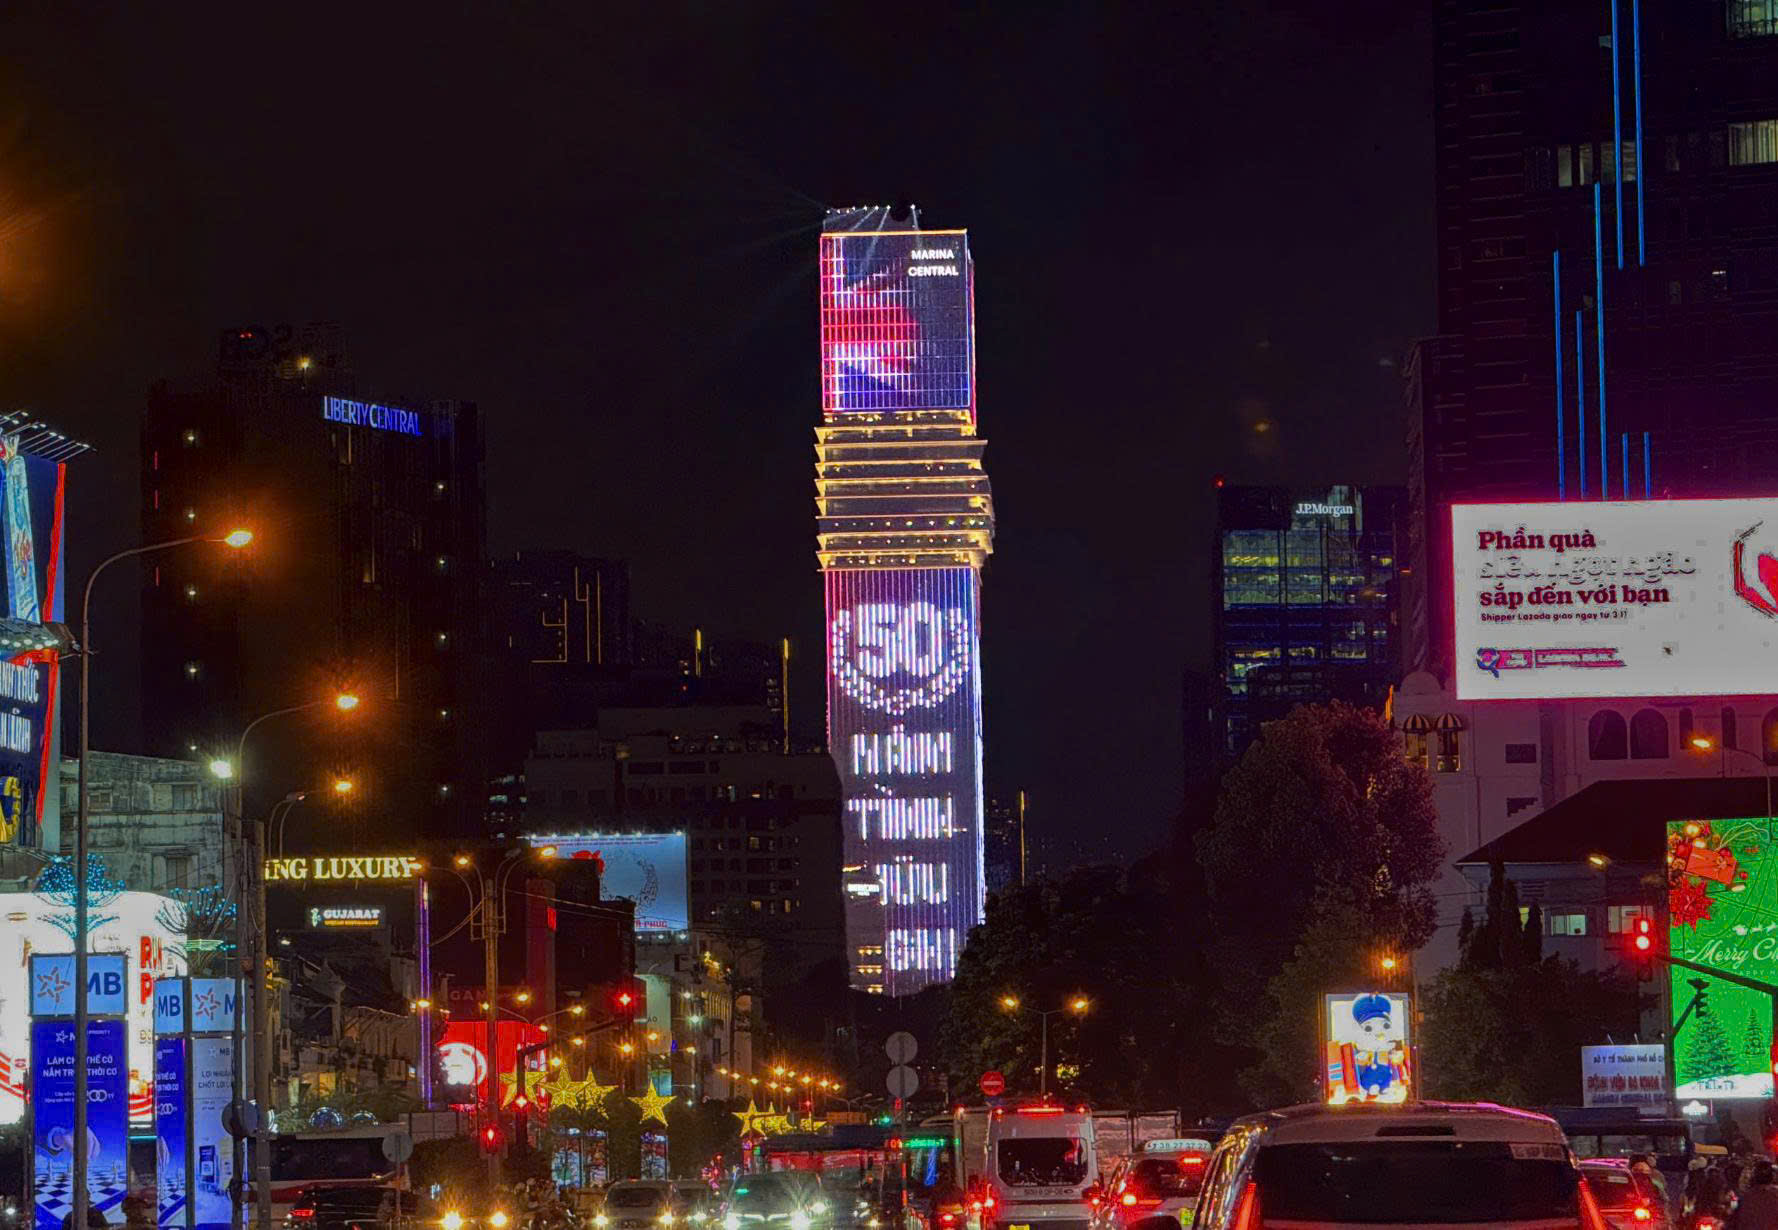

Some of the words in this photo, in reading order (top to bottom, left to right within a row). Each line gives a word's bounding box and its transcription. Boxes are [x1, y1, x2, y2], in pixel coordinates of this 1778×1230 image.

[911, 250, 954, 260] MARINA
[908, 266, 959, 277] CENTRAL
[324, 396, 368, 425] LIBERTY
[369, 404, 423, 436] CENTRAL
[1296, 503, 1353, 517] J.P.Morgan
[1478, 527, 1545, 550] Phần
[1549, 529, 1597, 553] quà
[1480, 582, 1523, 609] sắp
[1527, 582, 1574, 605] đến
[1575, 584, 1617, 605] với
[1622, 585, 1671, 607] bạn
[1480, 613, 1515, 622] Shipper
[1518, 613, 1551, 621] Lazada
[1575, 613, 1598, 622] ngay
[858, 601, 942, 678] 50
[314, 856, 416, 879] LUXURY
[323, 909, 380, 919] GUJARAT
[1688, 939, 1749, 970] Merry
[158, 995, 181, 1017] MB
[224, 993, 237, 1016] M
